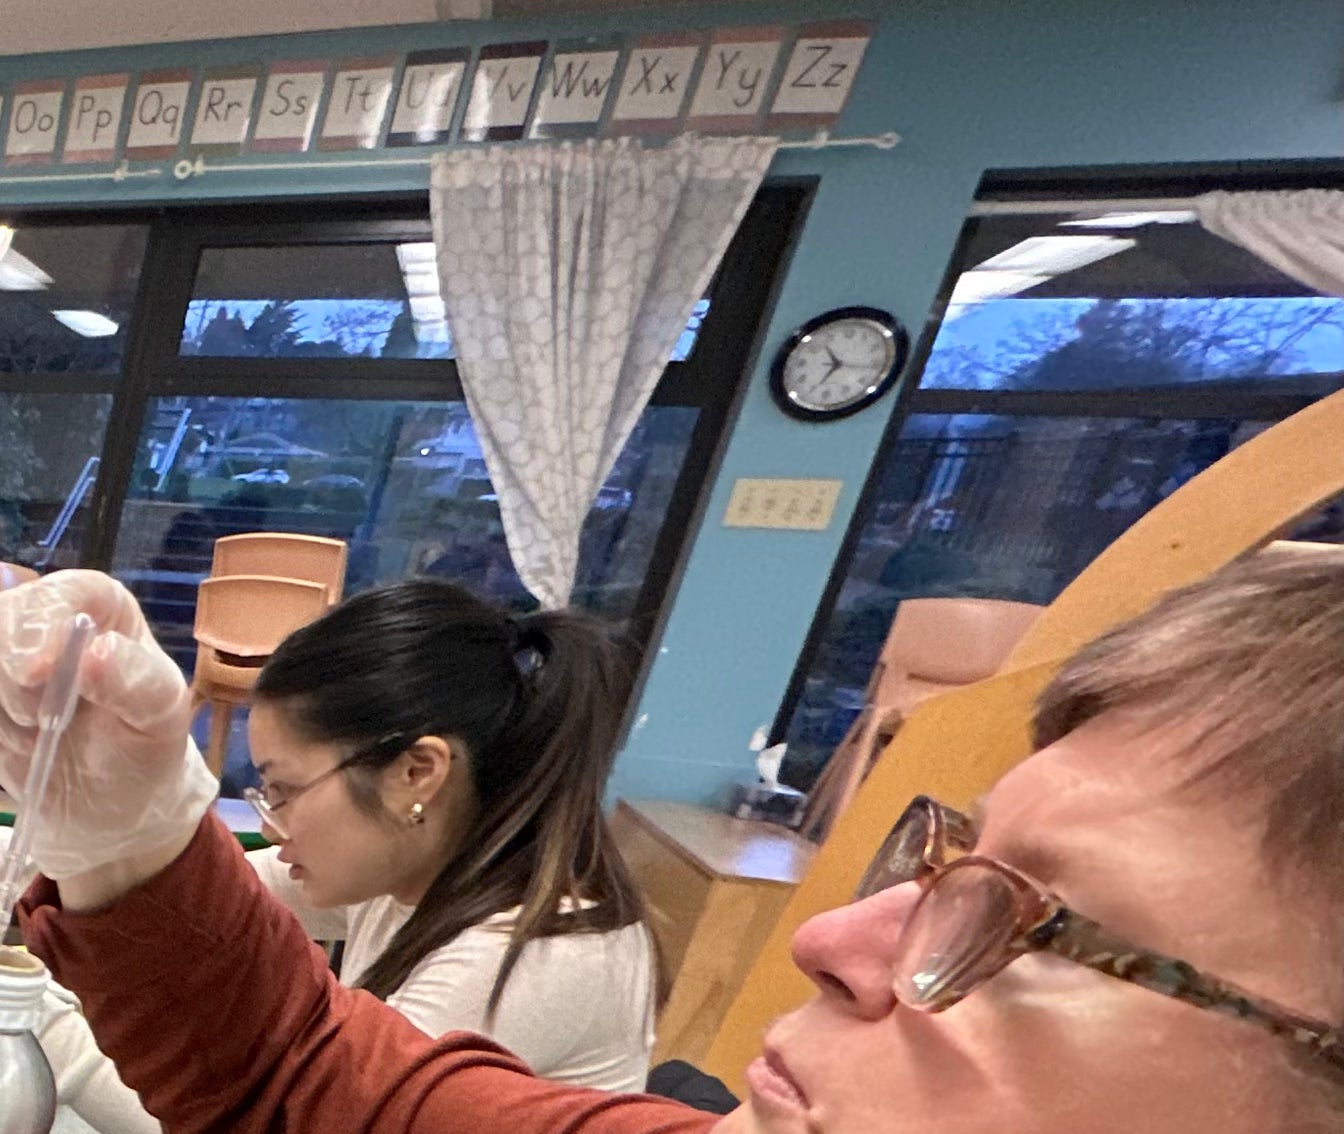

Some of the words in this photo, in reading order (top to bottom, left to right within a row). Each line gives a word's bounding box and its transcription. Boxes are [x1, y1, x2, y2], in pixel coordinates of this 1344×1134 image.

[15, 100, 54, 134] Oo
[76, 95, 112, 143] Pp
[139, 90, 180, 138] Qq
[204, 87, 242, 123] Rr
[269, 80, 309, 117] Ss
[344, 76, 375, 115] Tt
[552, 60, 612, 98] Ww
[630, 55, 680, 96] Xx
[719, 50, 762, 108] Yy
[790, 45, 848, 88] Zz
